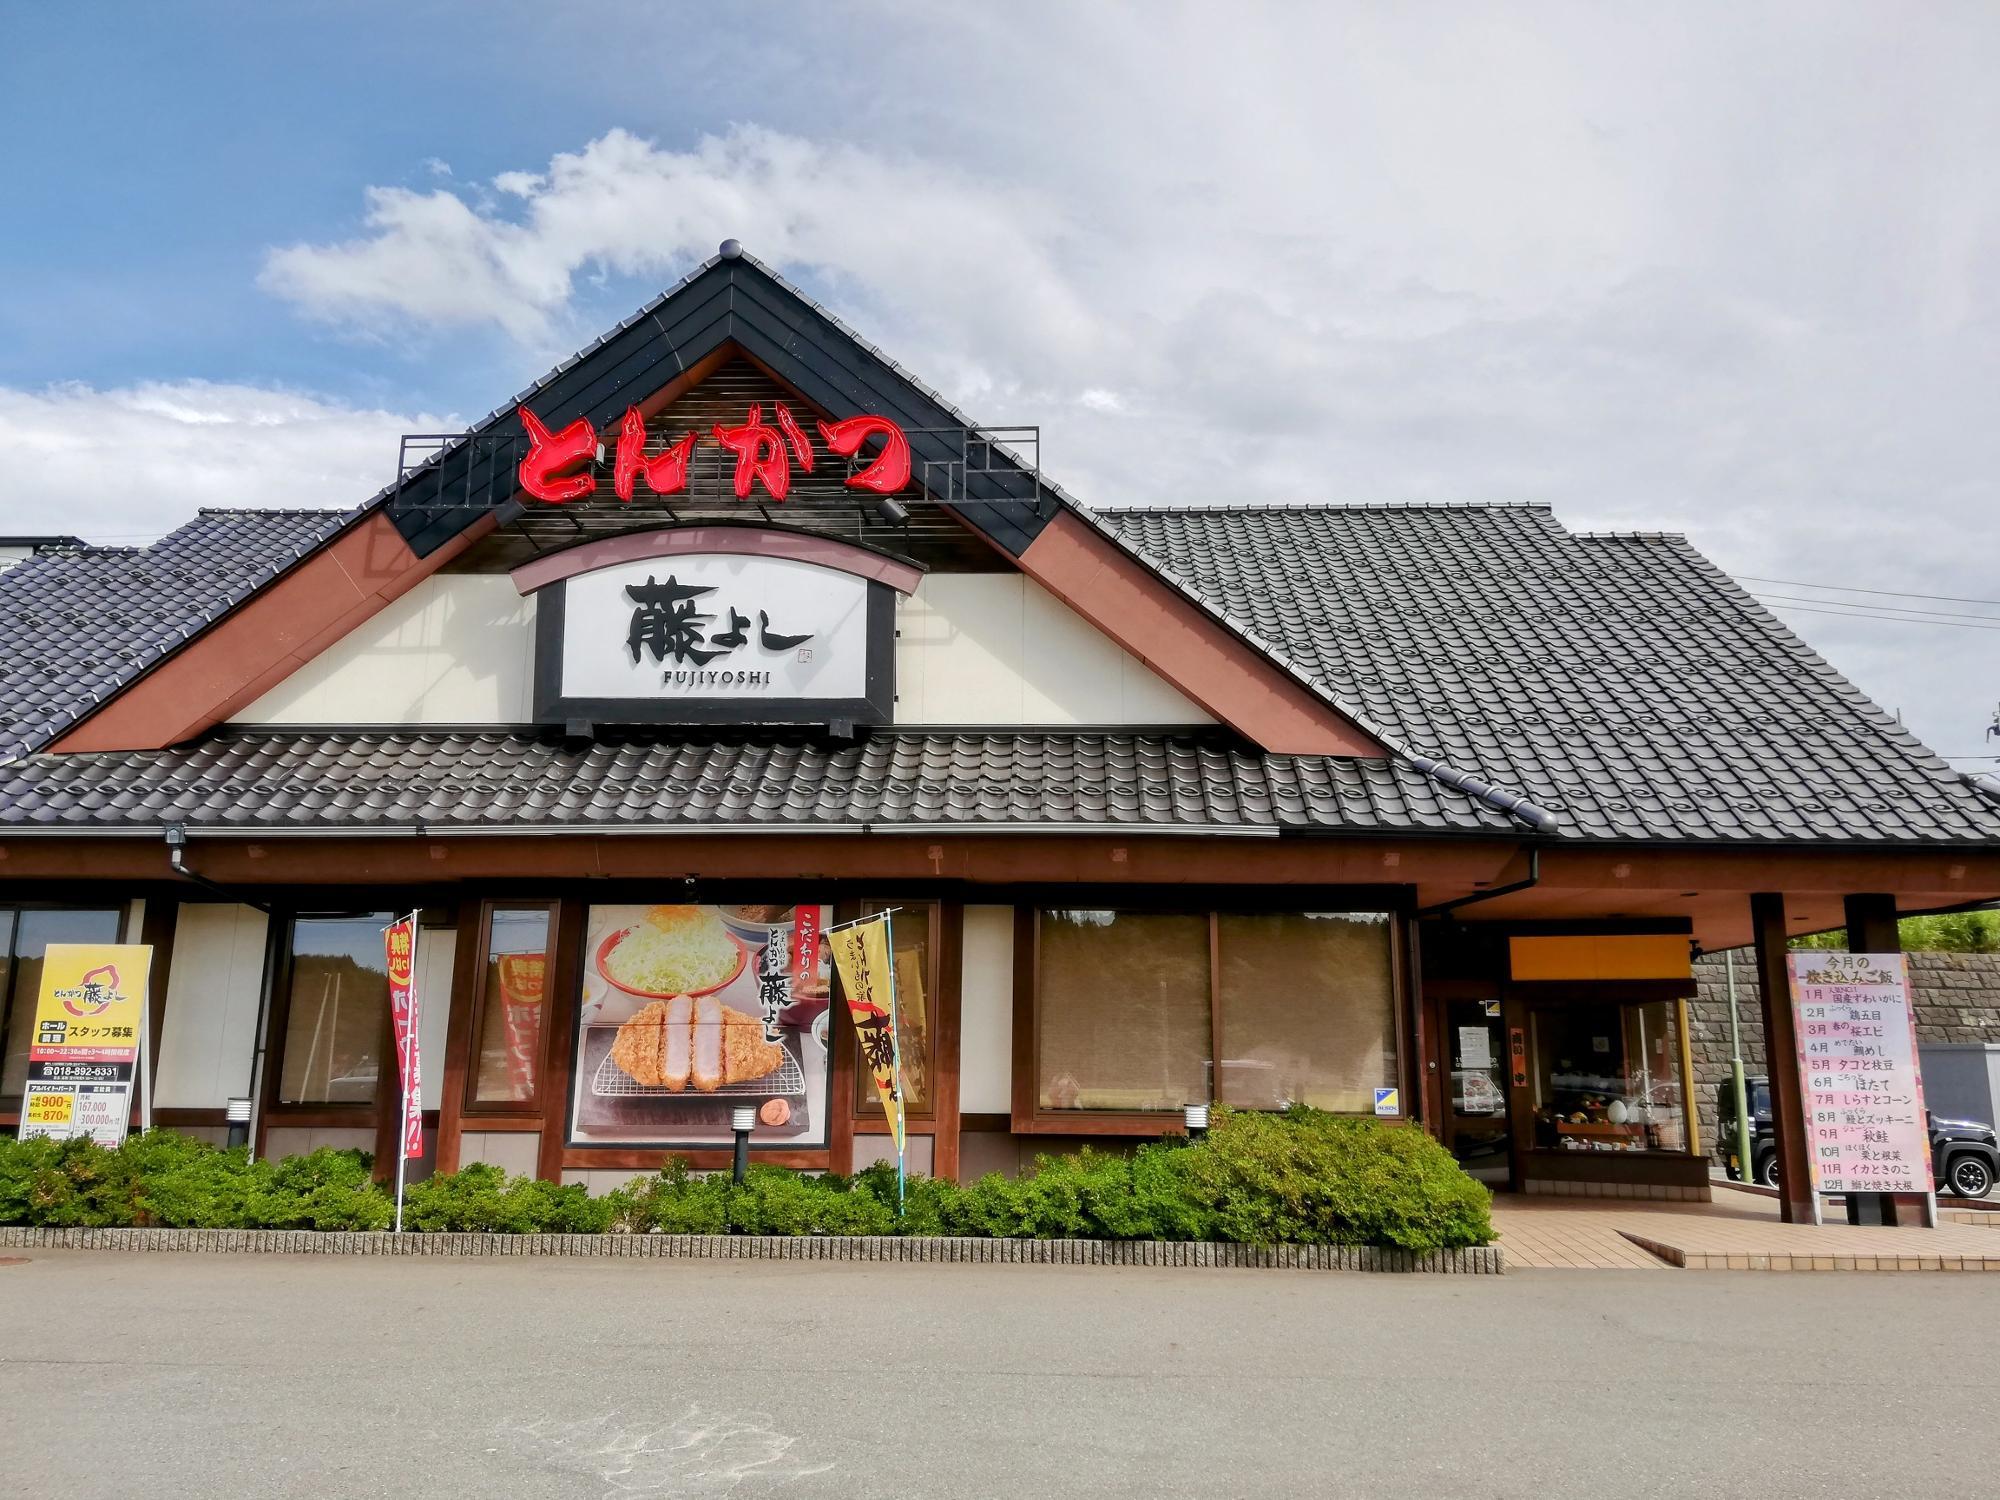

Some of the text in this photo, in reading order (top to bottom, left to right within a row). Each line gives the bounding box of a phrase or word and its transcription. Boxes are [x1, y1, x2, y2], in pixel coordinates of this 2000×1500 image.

[517, 401, 911, 503] とんかつ
[624, 575, 814, 667] 藤よし
[663, 671, 771, 684] FUJIYOSHI
[799, 913, 814, 981] こだわりの
[1826, 956, 1870, 970] 今月の
[1806, 969, 1894, 985] 炊き込みご飯
[759, 928, 800, 1042] とんかつ 藤よし
[54, 982, 128, 1004] とんかつ 藤よし
[1805, 990, 1823, 1000] 1月
[1833, 993, 1902, 1004] 国産ずわいがに
[1807, 1008, 1825, 1018] 2月
[42, 1022, 65, 1030] ホール
[1808, 1025, 1827, 1035] 3月
[1833, 1022, 1850, 1031] 春の
[1851, 1026, 1884, 1037] 桜エビ
[69, 1026, 133, 1038] スタッフ募集
[1810, 1042, 1828, 1053] 4月
[1812, 1060, 1830, 1070] 5月
[1839, 1060, 1894, 1071] タコと枝豆
[53, 1067, 117, 1076] 018-892-6331
[1814, 1077, 1832, 1088] 6月
[1856, 1080, 1889, 1091] ほたて
[1816, 1095, 1834, 1105] 7月
[1843, 1094, 1912, 1105] しらすとコーン
[1818, 1112, 1836, 1122] 8月
[1819, 1129, 1838, 1140] 9月
[1863, 1131, 1889, 1143] 秋鮭
[1820, 1147, 1839, 1158] 10月
[1822, 1164, 1841, 1174] 11月
[1850, 1164, 1910, 1175] イカときのこ
[1824, 1180, 1843, 1190] 12月
